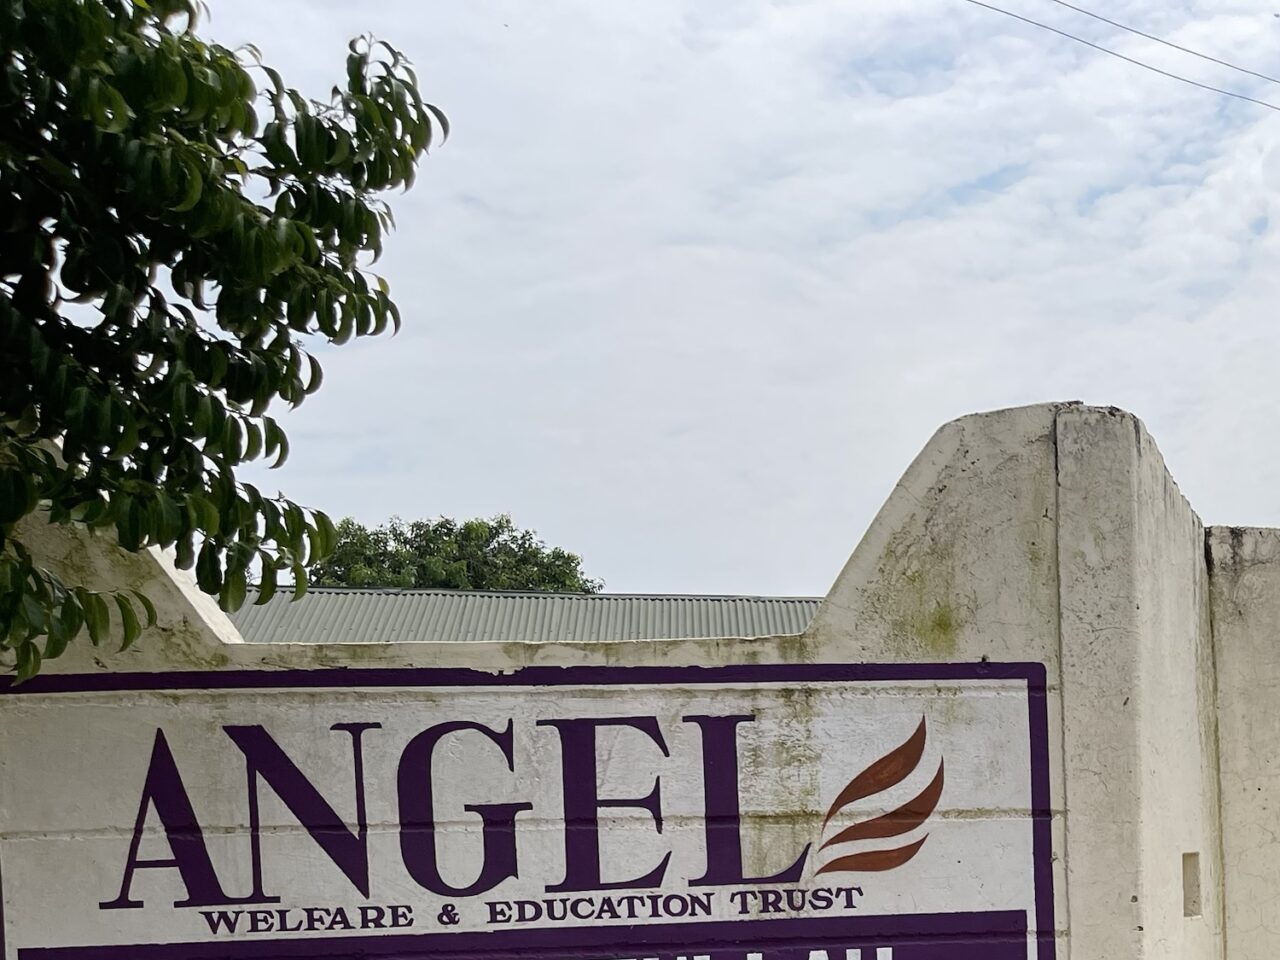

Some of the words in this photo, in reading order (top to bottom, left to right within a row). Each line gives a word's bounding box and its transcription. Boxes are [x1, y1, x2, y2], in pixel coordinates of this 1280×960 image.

[98, 714, 812, 910] ANGEL
[199, 903, 414, 935] WELFARE
[437, 903, 461, 926] &
[486, 890, 715, 924] EDUCATION
[730, 886, 864, 915] TRUST
